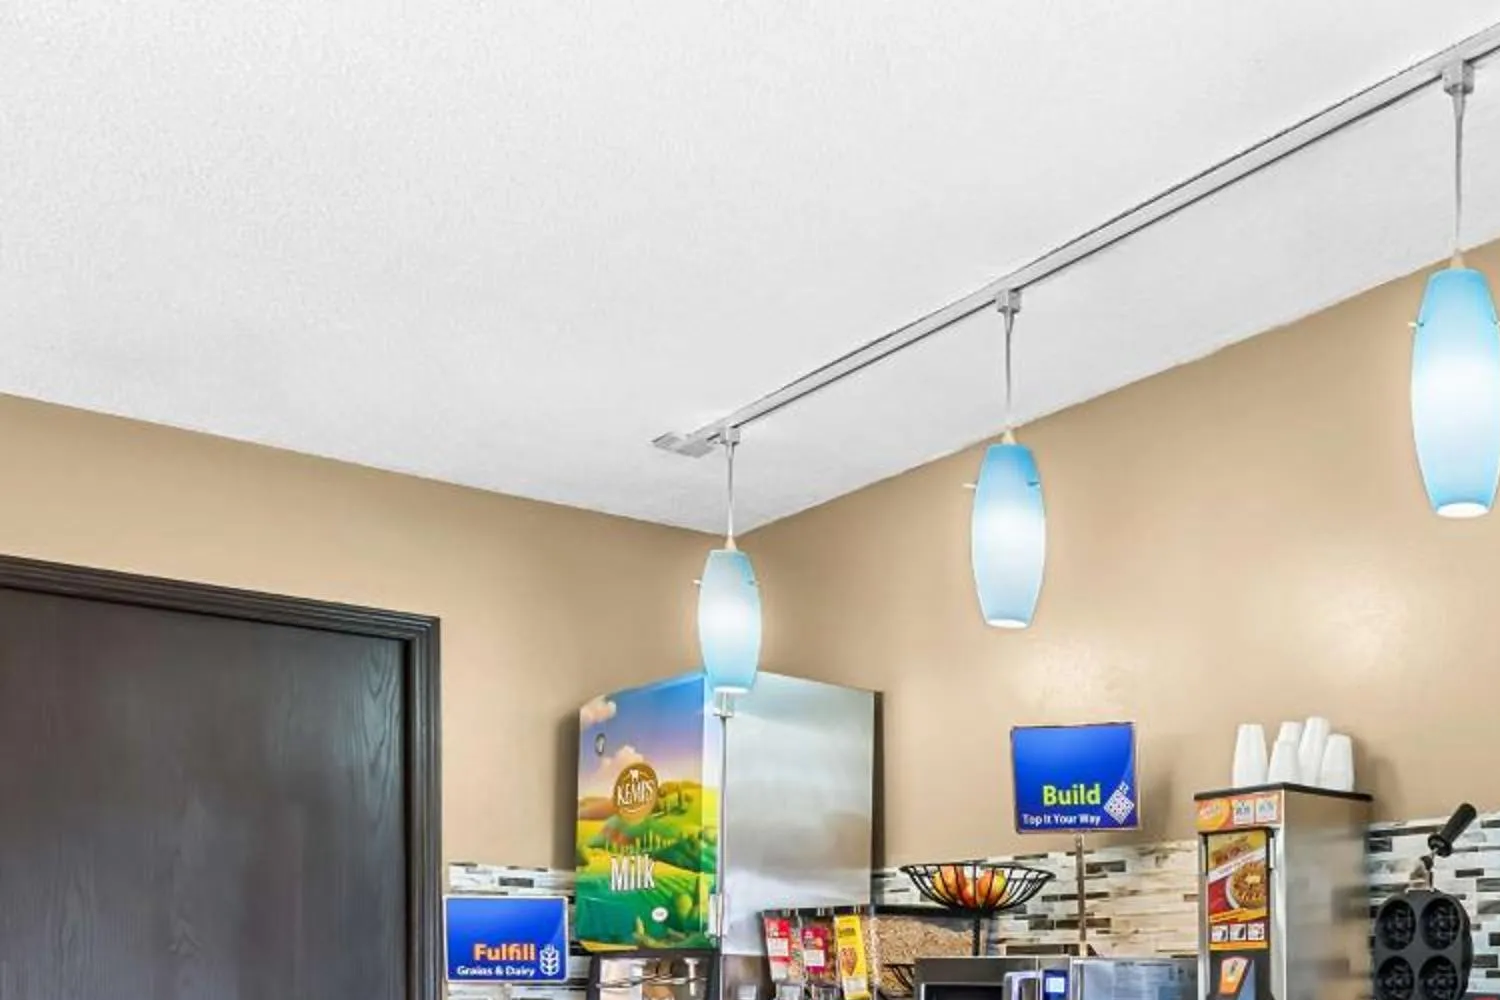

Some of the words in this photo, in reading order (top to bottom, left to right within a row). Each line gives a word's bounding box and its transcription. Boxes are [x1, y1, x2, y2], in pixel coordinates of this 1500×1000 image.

[1043, 783, 1101, 806] Build
[1053, 813, 1077, 825] Your
[1079, 813, 1102, 826] Way
[611, 853, 655, 891] Milk
[473, 943, 536, 961] Fulfill
[456, 965, 494, 976] Grains
[494, 965, 504, 976] &
[505, 965, 536, 977] Dairy
